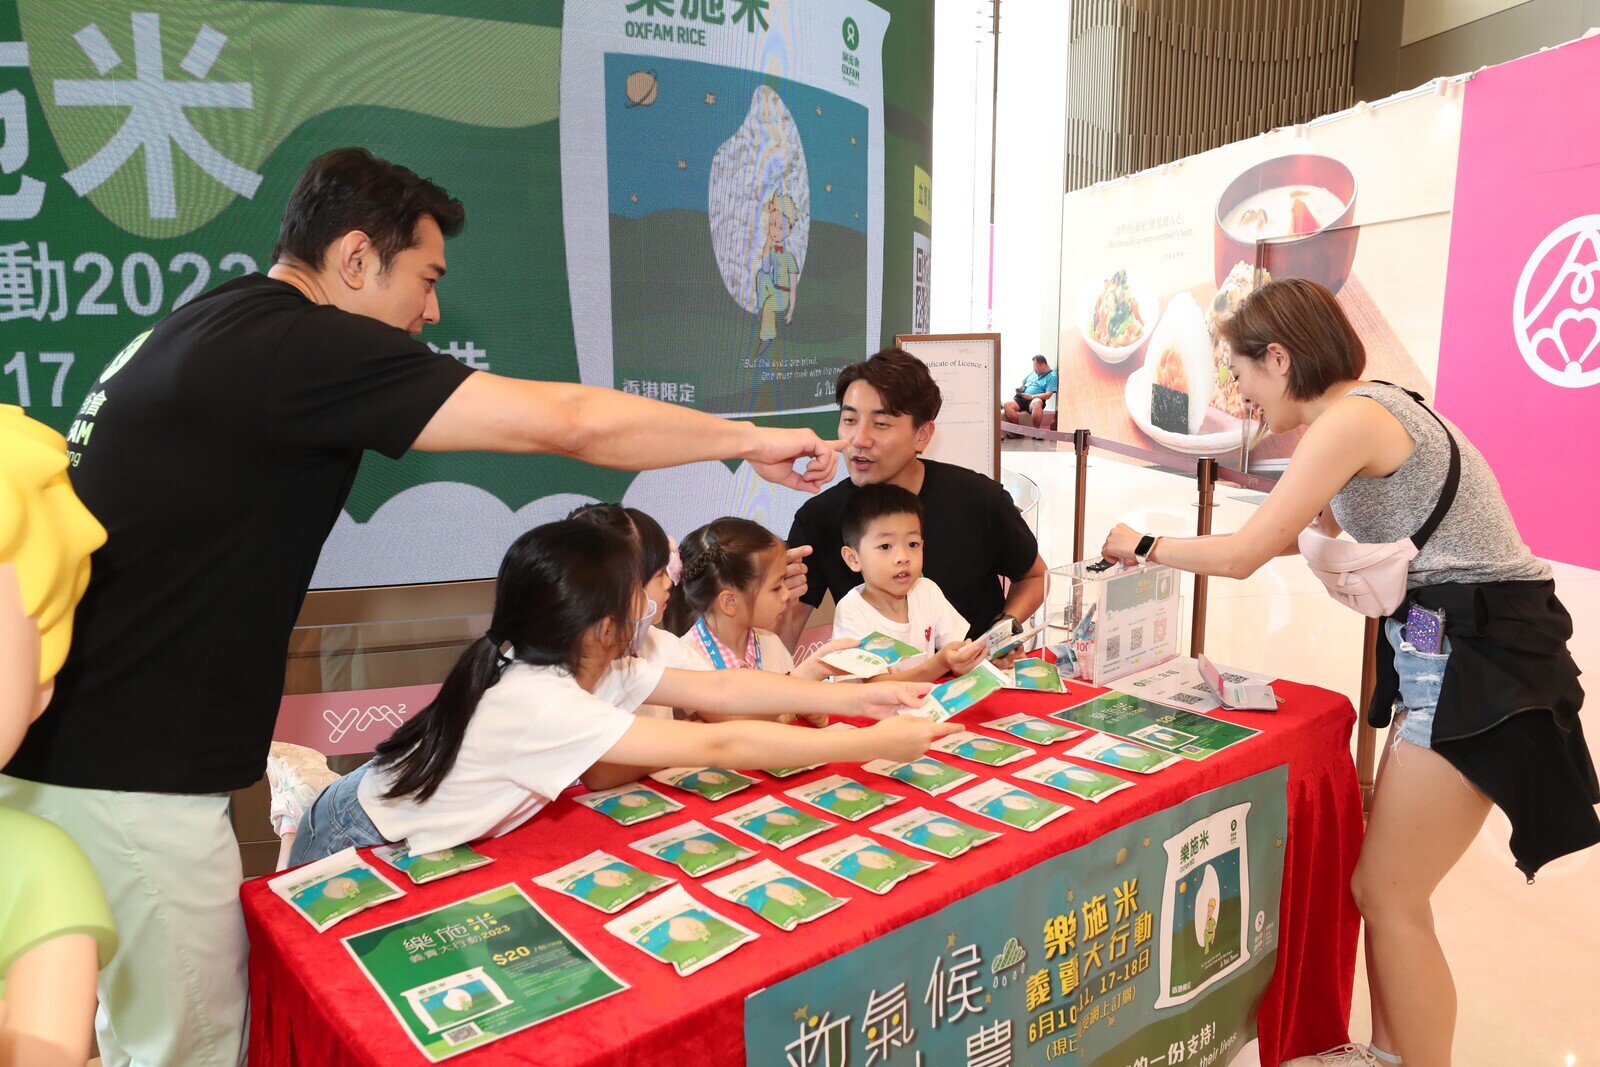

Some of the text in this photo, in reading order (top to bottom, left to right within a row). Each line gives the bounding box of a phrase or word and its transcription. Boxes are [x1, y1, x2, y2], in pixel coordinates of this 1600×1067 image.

[625, 20, 706, 46] OXFAM RICE
[3, 351, 75, 408] 17
[925, 359, 982, 369] tificate of Licence
[622, 379, 696, 404] 香港限定
[1179, 830, 1209, 865] 樂施米
[402, 912, 498, 955] 樂施米
[1043, 876, 1139, 960] 樂施米
[491, 945, 531, 967] $20
[1025, 910, 1154, 1013] 義賣大行動
[1126, 1021, 1216, 1067] 的一份支持!
